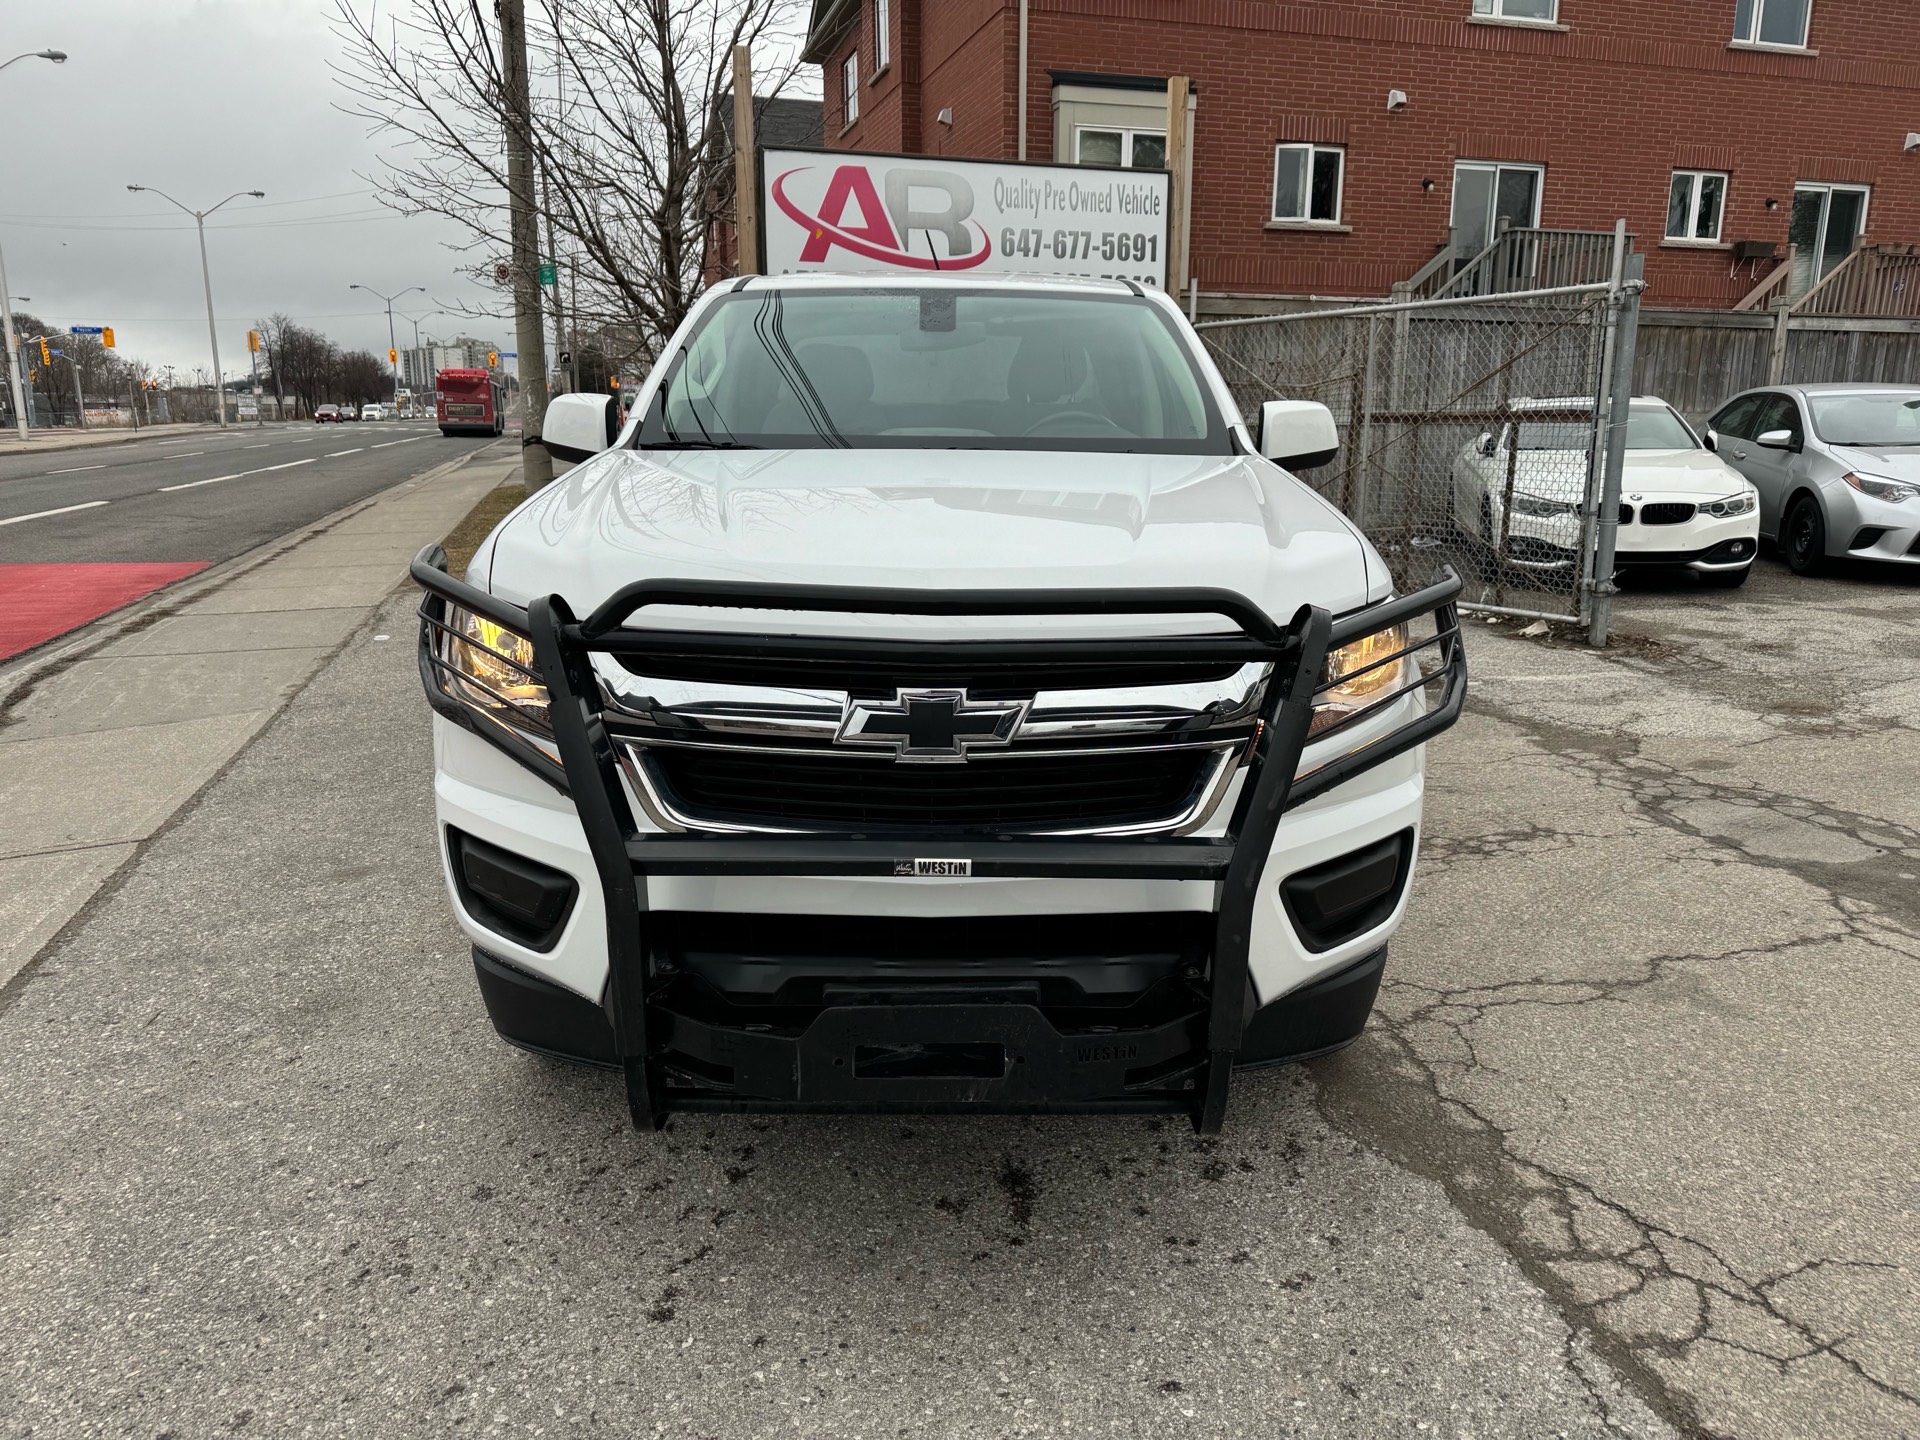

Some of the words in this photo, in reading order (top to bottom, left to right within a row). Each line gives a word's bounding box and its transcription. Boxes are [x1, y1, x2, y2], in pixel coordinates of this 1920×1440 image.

[799, 165, 974, 262] AR
[994, 176, 1041, 219] Quality
[1044, 179, 1066, 212] Pre
[1069, 180, 1112, 213] Owned
[1116, 183, 1160, 216] Vehicle
[1000, 227, 1158, 262] 647-677-5691
